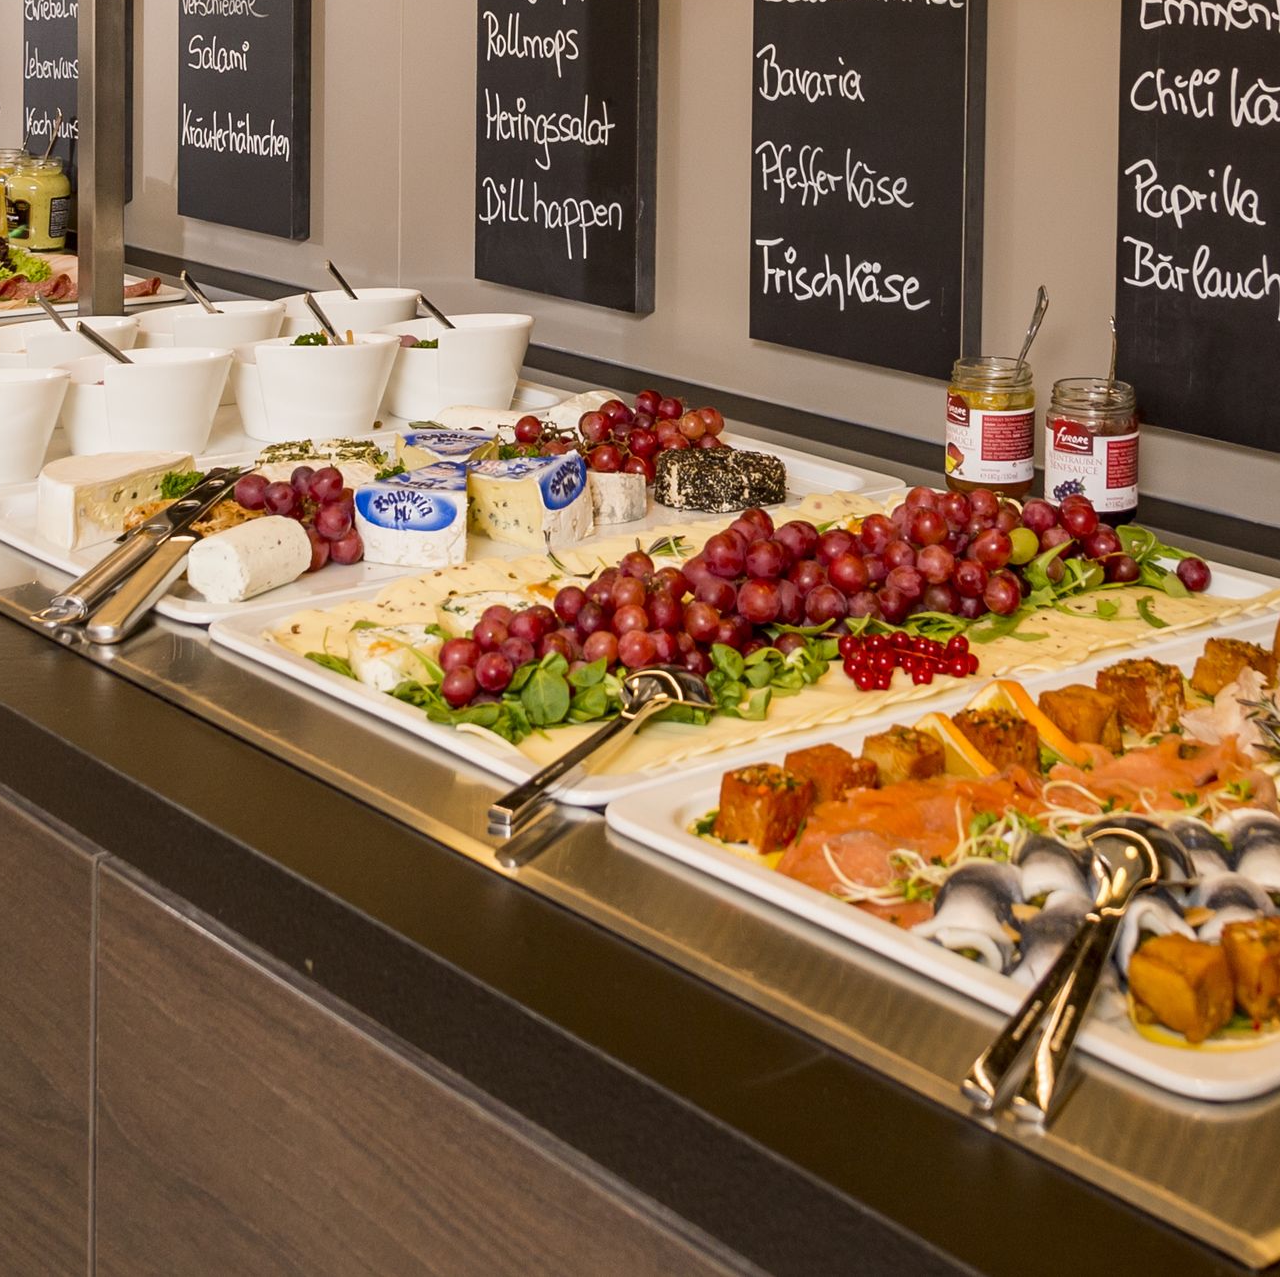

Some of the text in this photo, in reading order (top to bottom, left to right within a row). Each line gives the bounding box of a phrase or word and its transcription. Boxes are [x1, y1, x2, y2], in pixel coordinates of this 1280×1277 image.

[24, 41, 78, 80] Leberwurs
[188, 34, 250, 72] Salami
[483, 11, 579, 77] Rollmops
[756, 44, 864, 103] Bavaria
[1130, 68, 1220, 118] Chili
[25, 107, 78, 140] Kochwurs
[181, 103, 290, 162] Kräuterhähnchen
[485, 88, 615, 171] Heringssalat
[755, 141, 914, 208] Pfefferkäse
[1125, 159, 1266, 228] Paprika
[756, 239, 930, 311] Frischkäse
[373, 490, 434, 518] Bavaria
